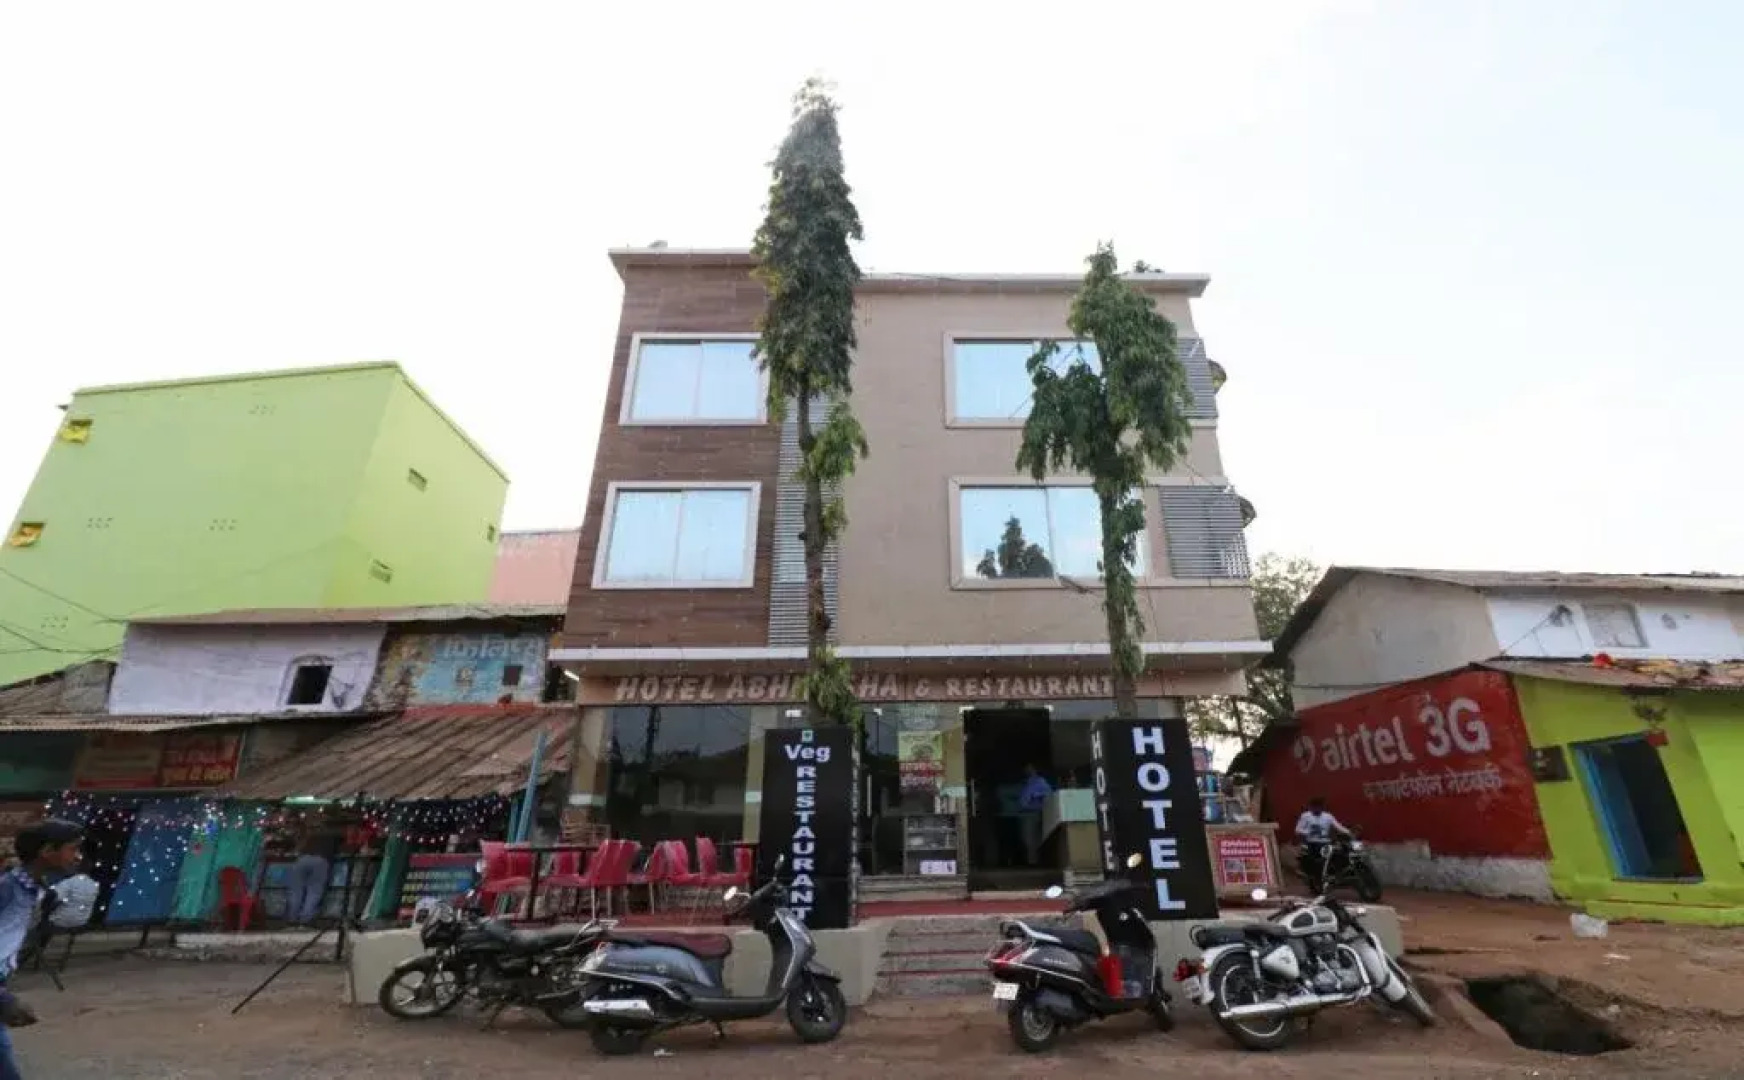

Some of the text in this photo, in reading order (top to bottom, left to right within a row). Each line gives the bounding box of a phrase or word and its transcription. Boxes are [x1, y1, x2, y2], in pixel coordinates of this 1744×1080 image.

[616, 674, 1116, 701] HOTEL ABHIHA & RESTAURANT
[1320, 697, 1493, 771] airtel 3G
[784, 743, 831, 763] Veg
[1091, 729, 1115, 871] HOTE
[790, 765, 817, 921] RESTAURANT
[1131, 726, 1187, 911] HOTEL
